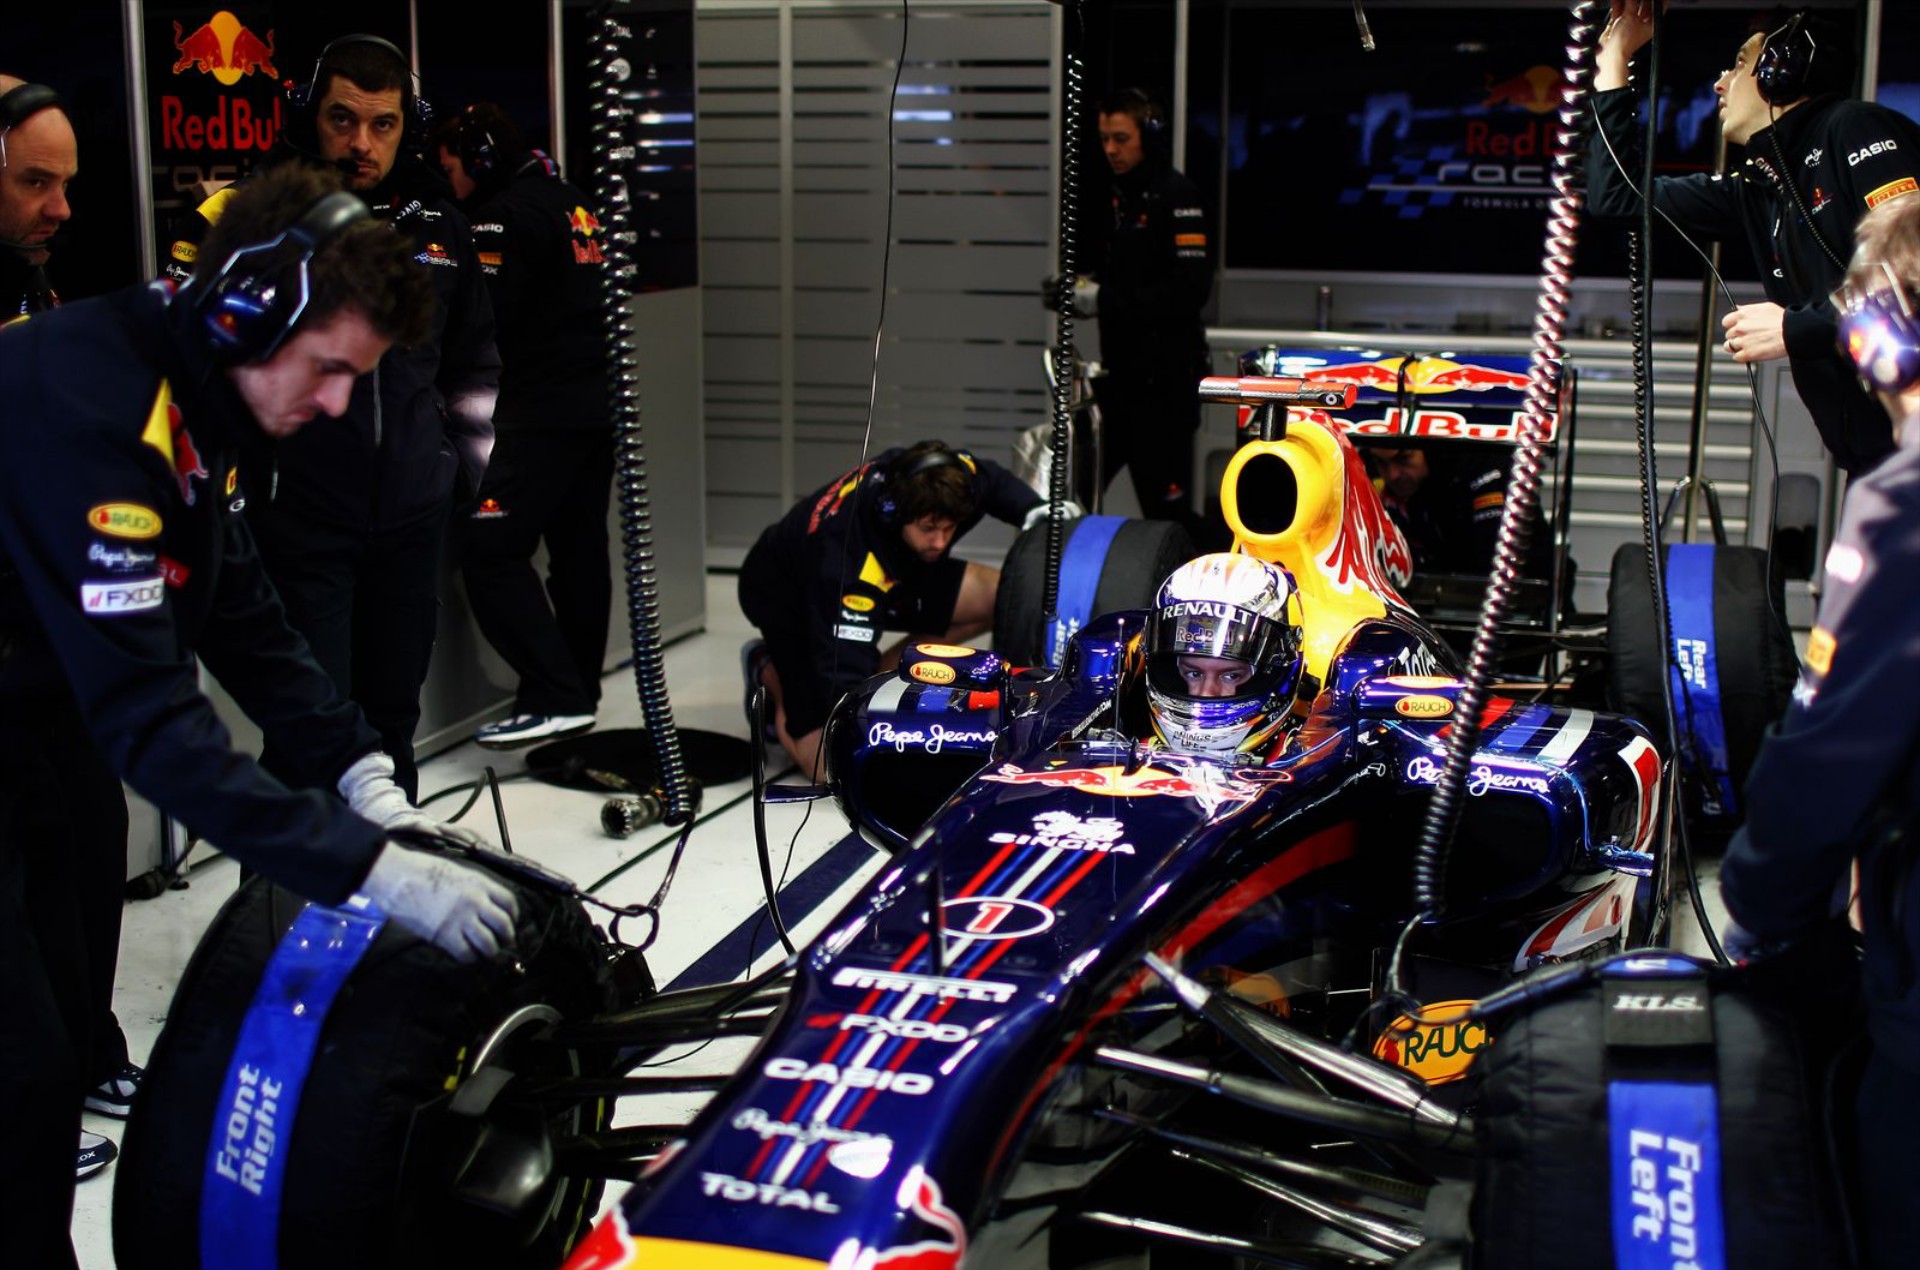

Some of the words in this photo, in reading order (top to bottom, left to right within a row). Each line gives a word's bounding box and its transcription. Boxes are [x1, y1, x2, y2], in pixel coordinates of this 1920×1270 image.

[162, 95, 228, 150] Red
[1466, 120, 1537, 156] Red
[1848, 139, 1898, 167] CASIO
[1462, 197, 1531, 209] FORMULA
[1162, 602, 1254, 625] RENAULT
[921, 670, 950, 680] RAUCH
[1677, 638, 1693, 682] Left
[1691, 639, 1708, 690] Rear
[1411, 703, 1447, 712] RAUCH
[868, 721, 926, 753] Pepe
[924, 723, 998, 754] Jeans
[1469, 765, 1551, 797] Jeans
[988, 832, 1136, 855] SINGHA
[965, 902, 1015, 934] 1
[832, 966, 1018, 1003] PIRELLI
[839, 1013, 969, 1043] FXDD
[764, 1057, 935, 1095] CASIO
[216, 1063, 260, 1182] Front
[241, 1076, 283, 1197] Right
[702, 1171, 841, 1214] TOTAL
[1629, 1128, 1667, 1242] Left
